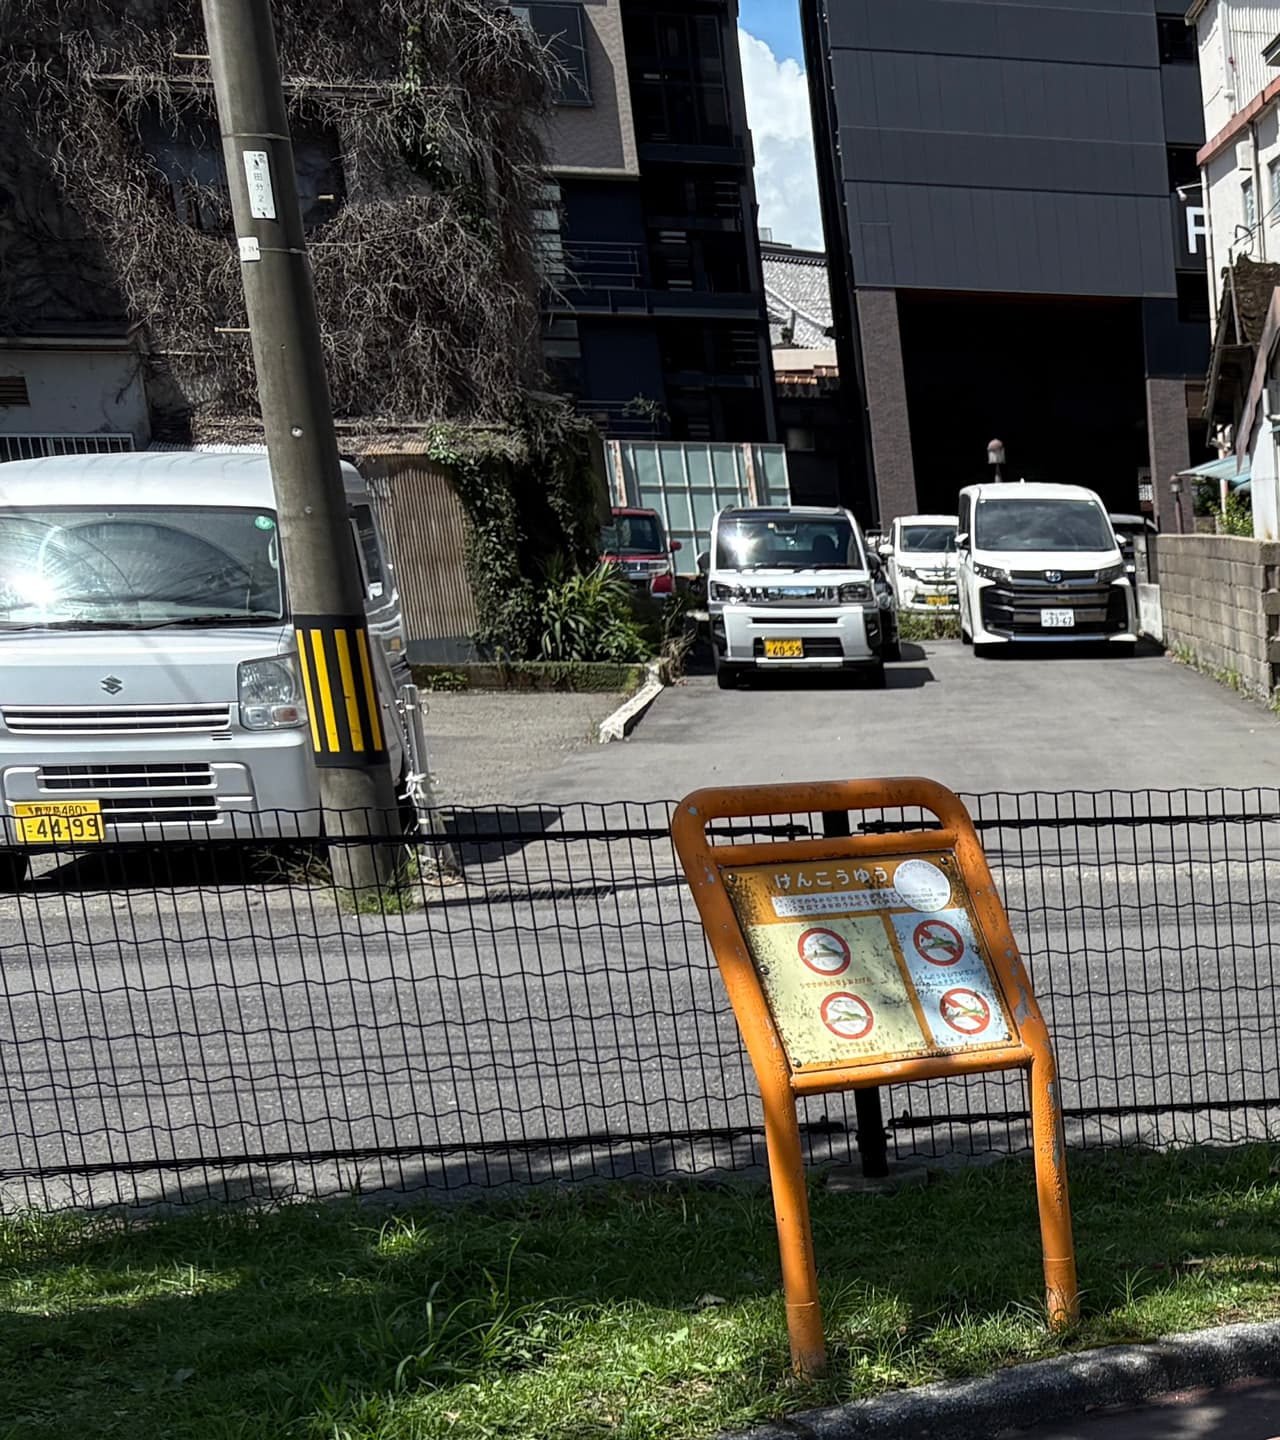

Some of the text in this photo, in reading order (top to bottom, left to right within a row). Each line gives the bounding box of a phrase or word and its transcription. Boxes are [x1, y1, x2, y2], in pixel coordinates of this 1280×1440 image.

[775, 867, 888, 889] けんこうゆう
